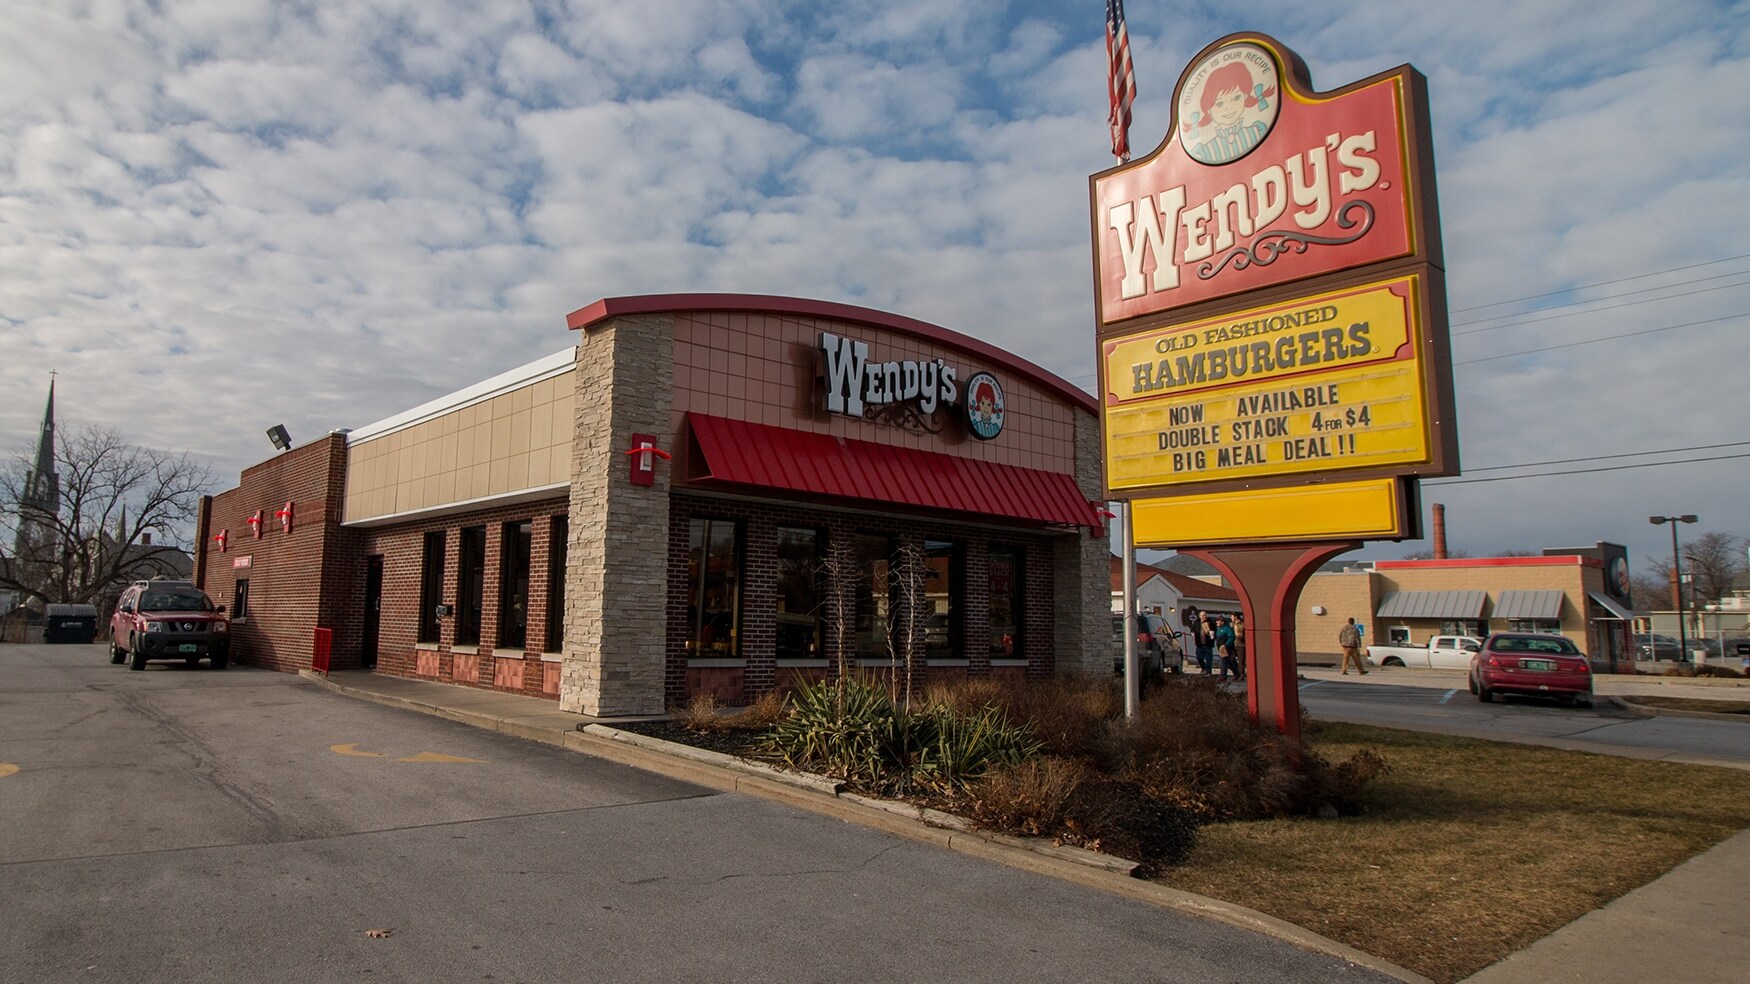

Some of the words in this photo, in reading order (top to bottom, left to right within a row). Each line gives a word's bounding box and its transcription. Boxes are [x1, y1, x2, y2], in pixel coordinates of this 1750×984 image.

[1184, 66, 1208, 105] QUALITY
[1210, 58, 1219, 67] IS
[1223, 52, 1242, 61] OUR
[1244, 52, 1271, 75] RECIPE
[1110, 129, 1381, 300] Wendy's
[1155, 333, 1197, 354] OLD
[1203, 305, 1338, 345] FASHIONED
[822, 332, 957, 417] Wendy's
[1132, 321, 1371, 393] HAMBURGERS
[1158, 425, 1220, 450] DOUBLE
[1232, 416, 1289, 442] STACK
[1311, 411, 1323, 431] 4
[1325, 419, 1342, 431] FOR
[1345, 405, 1371, 428] $4
[1169, 404, 1204, 426] NOW
[1236, 384, 1339, 417] AVAILABLE
[1173, 450, 1206, 472] BIG
[1217, 444, 1266, 468] MEAL
